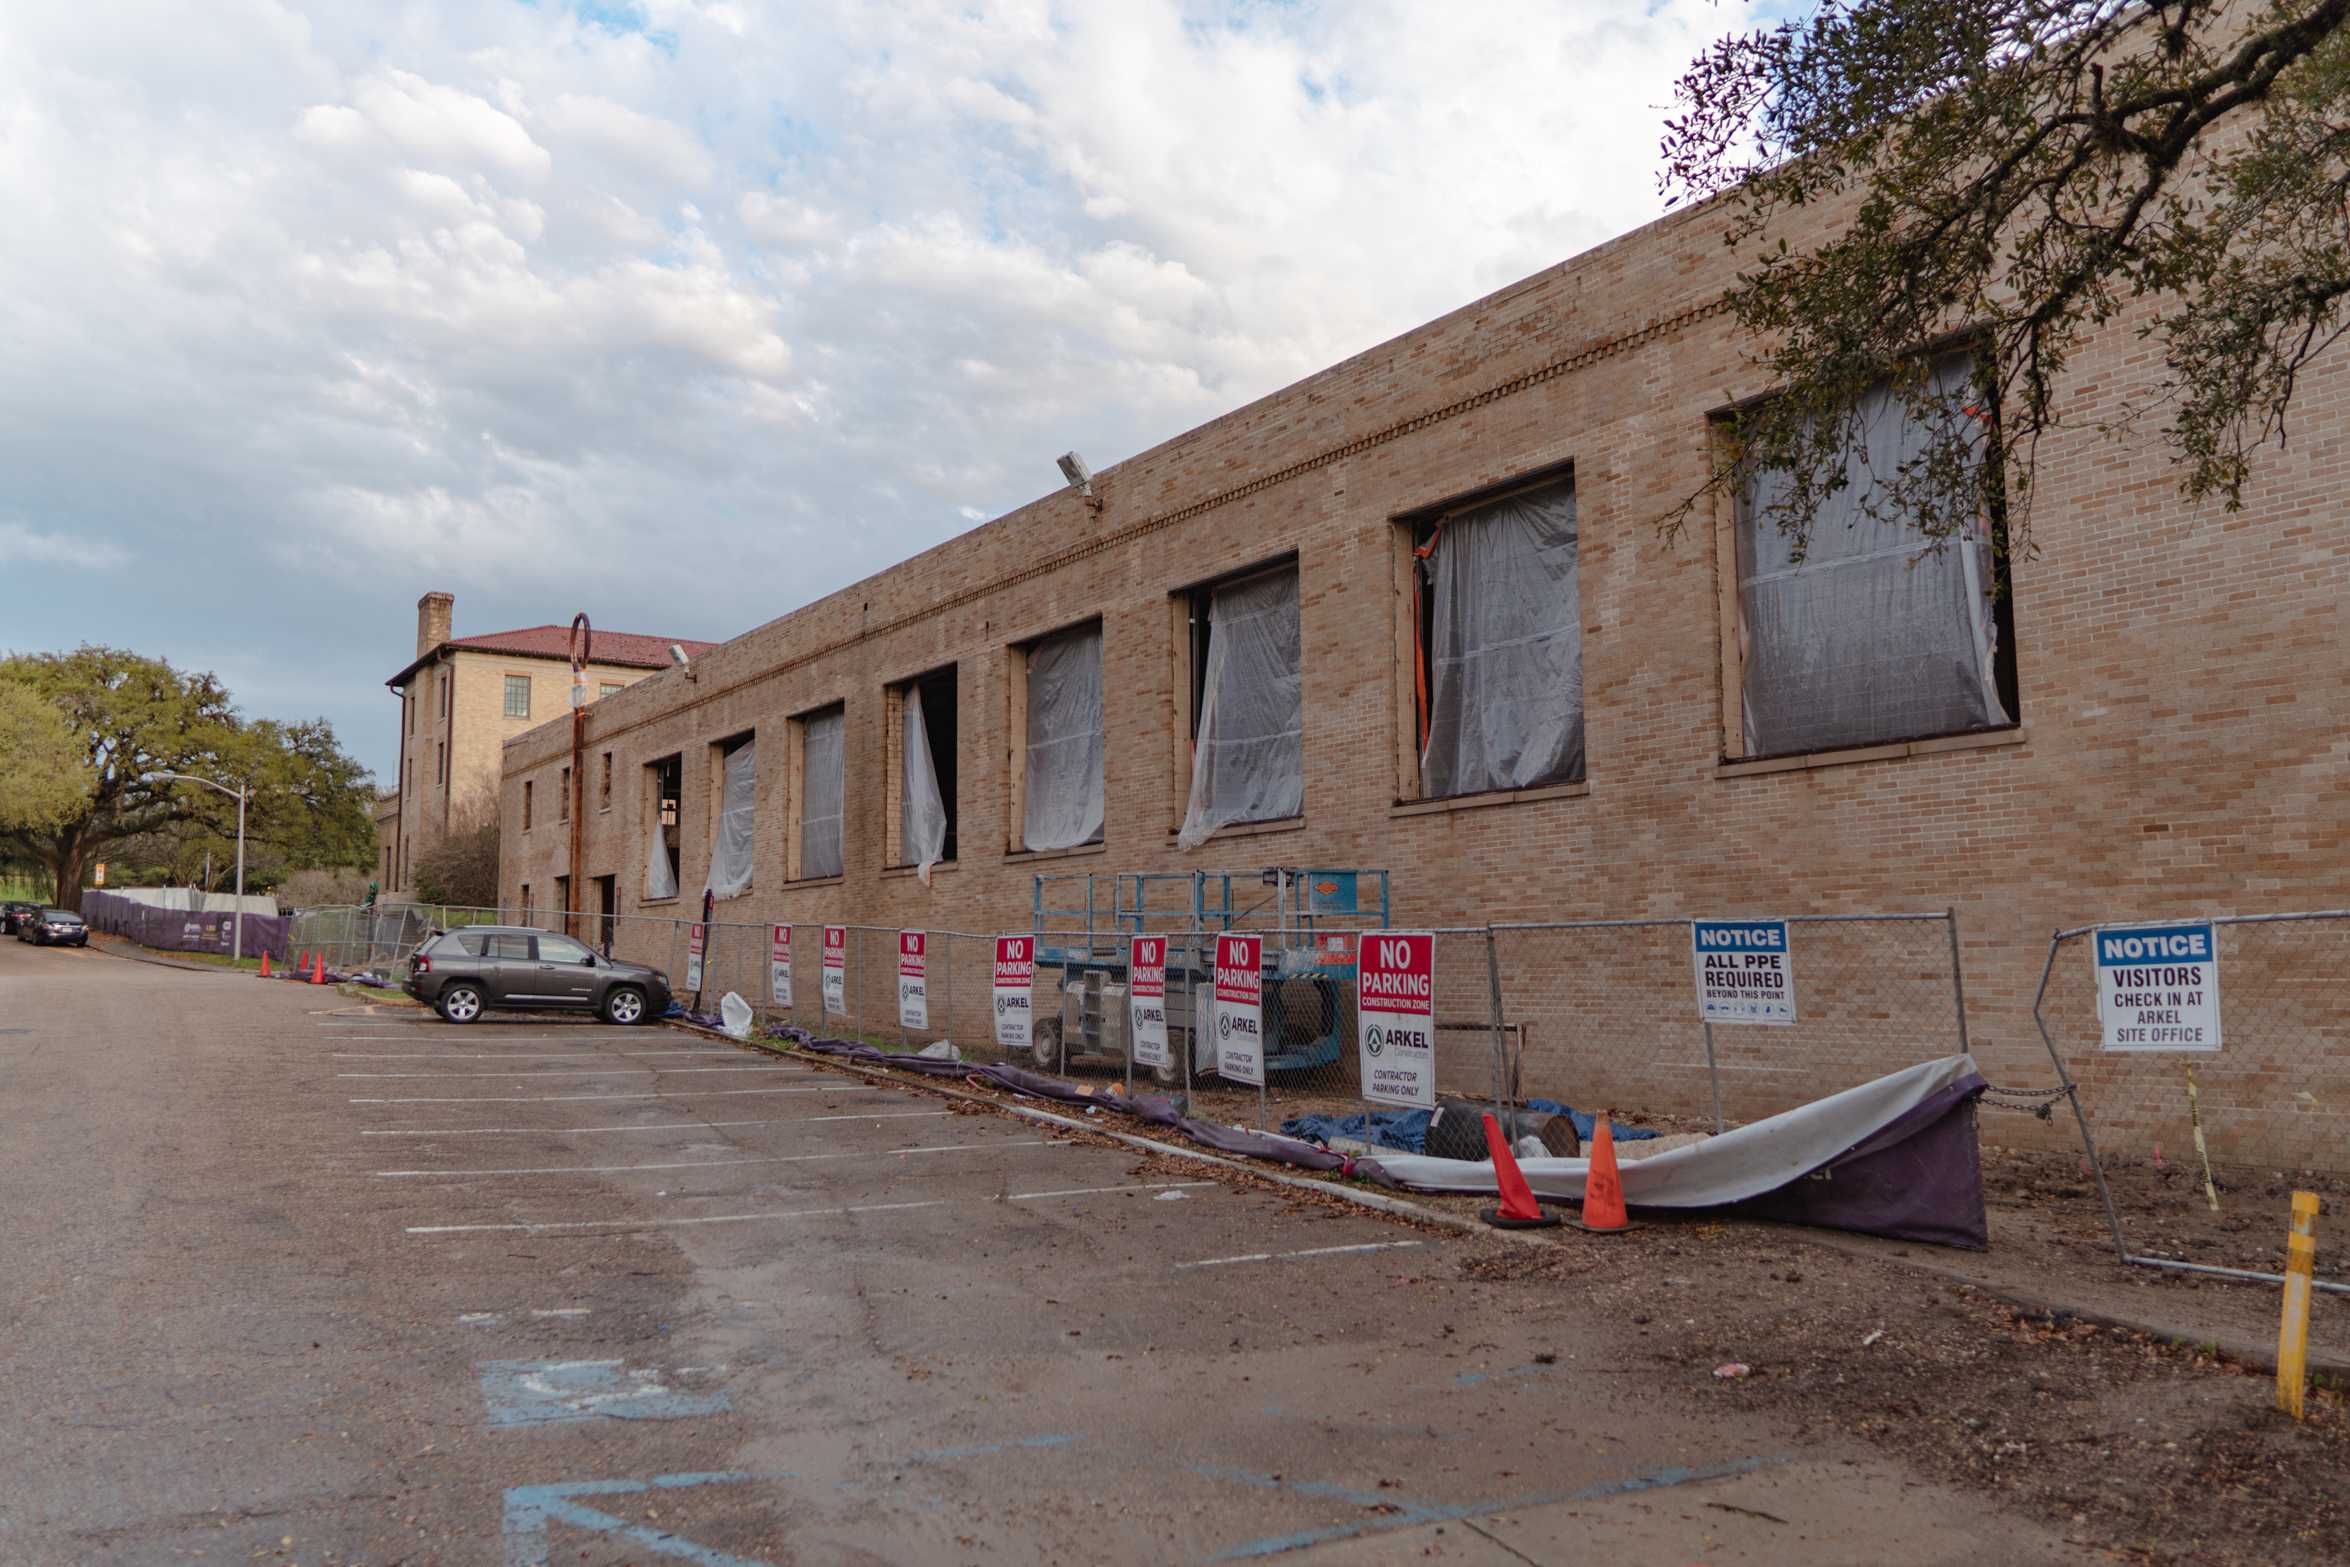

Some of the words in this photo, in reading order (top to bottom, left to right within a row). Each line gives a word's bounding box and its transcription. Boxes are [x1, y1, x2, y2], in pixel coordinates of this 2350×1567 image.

[830, 930, 839, 945] NO
[907, 936, 918, 952] NO
[1700, 929, 1781, 946] NOTICE
[1007, 941, 1023, 959] NO
[1141, 942, 1156, 963] NO
[1229, 940, 1249, 966] NO
[1380, 940, 1411, 969] NO
[2104, 934, 2207, 959] NOTICE
[997, 961, 1032, 976] PARKING
[1705, 955, 1739, 969] ALL
[1745, 955, 1781, 969] PPE
[1133, 966, 1163, 982] PARKING
[1217, 967, 1259, 989] PARKING
[1705, 971, 1783, 988] REQUIRED
[2113, 966, 2202, 988] VISITORS
[1362, 972, 1429, 996] PARKING
[1007, 997, 1029, 1008] ARKEL
[1706, 989, 1738, 998] BEYOND
[1740, 990, 1759, 999] THIS
[1761, 990, 1785, 1000] POINT
[2114, 992, 2163, 1007] CHECK
[2168, 992, 2182, 1006] IN
[2187, 991, 2203, 1006] AT
[1362, 996, 1412, 1009] CONSTRUCTION
[1413, 999, 1430, 1010] ZONE
[1143, 1008, 1164, 1022] ARKEL
[2137, 1010, 2182, 1024] ARKEL
[1232, 1016, 1258, 1034] ARKEL
[1385, 1029, 1429, 1049] ARKEL
[2117, 1028, 2146, 1042] SITE
[2151, 1027, 2203, 1042] OFFICE
[1374, 1070, 1417, 1082] CONTRACTOR
[1372, 1083, 1400, 1095] PARKING
[1401, 1086, 1419, 1096] ONLY
